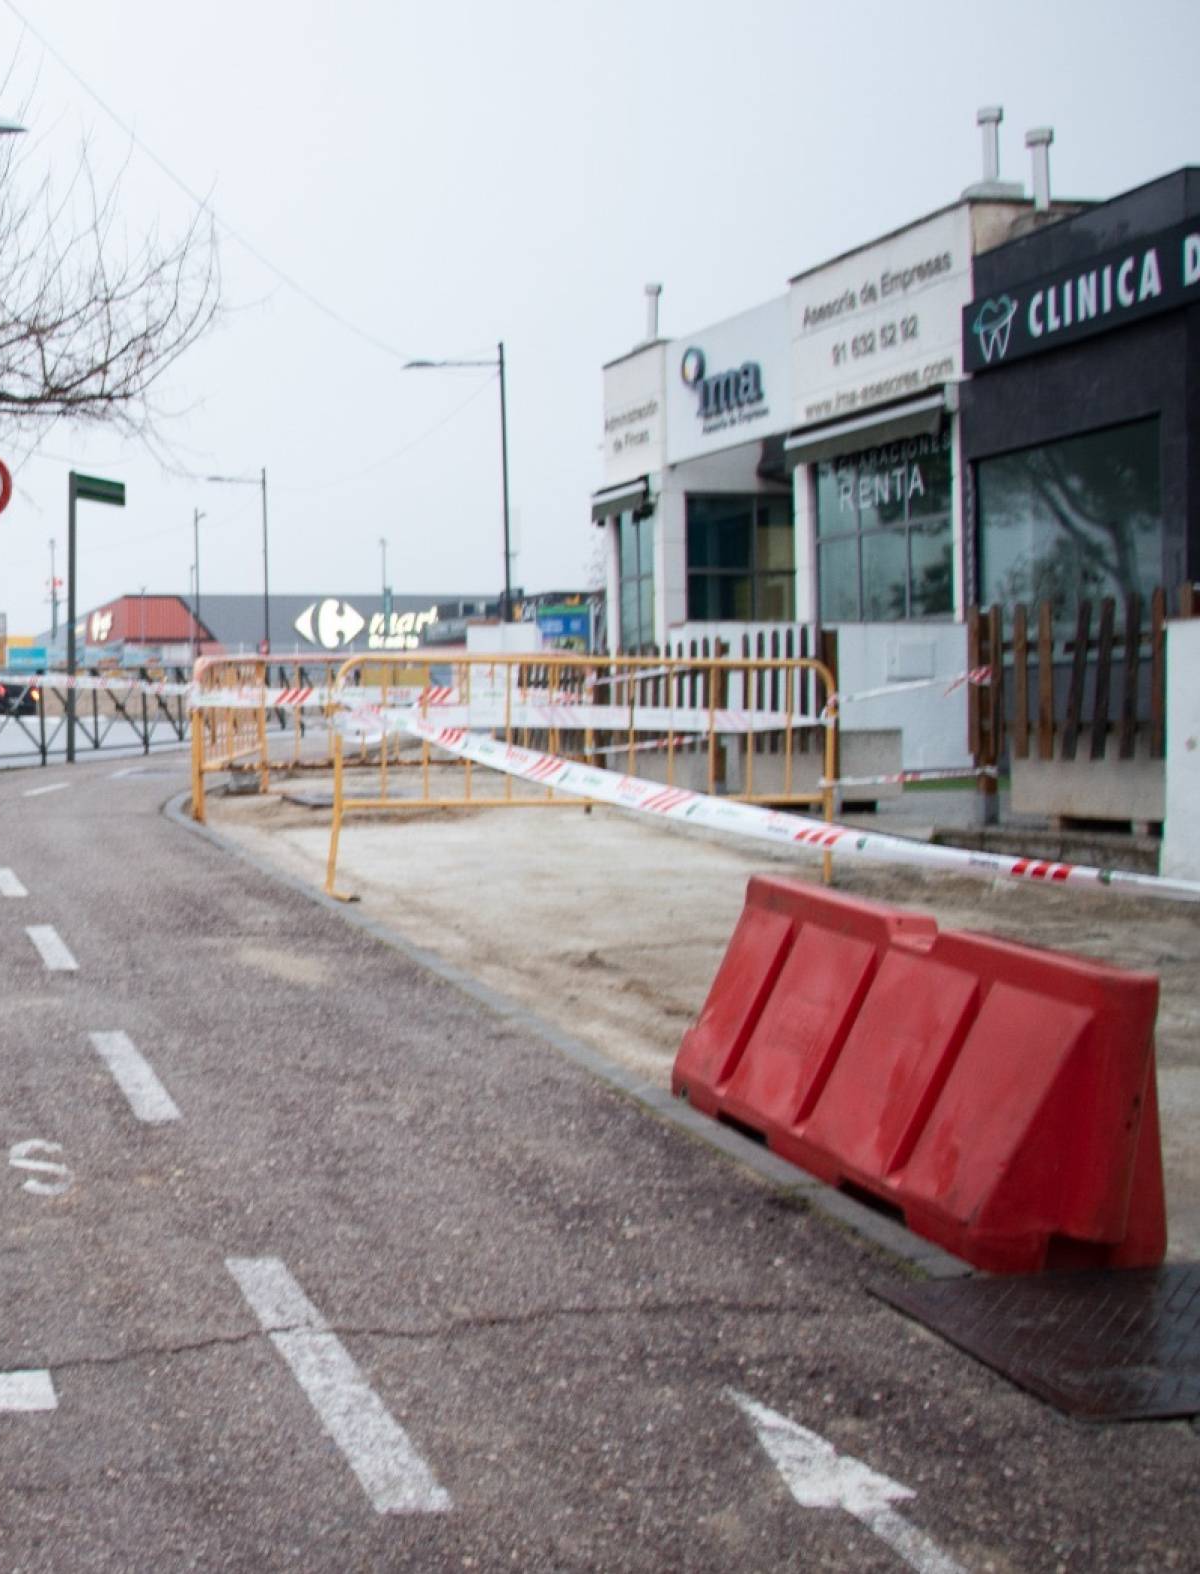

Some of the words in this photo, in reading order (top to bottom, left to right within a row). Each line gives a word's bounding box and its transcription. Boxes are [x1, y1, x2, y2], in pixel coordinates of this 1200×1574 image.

[860, 279, 877, 304] de
[880, 252, 952, 297] Empresas
[1028, 248, 1162, 338] CLINICA
[832, 341, 846, 366] 91
[851, 331, 876, 358] 632
[839, 463, 925, 513] RENTA
